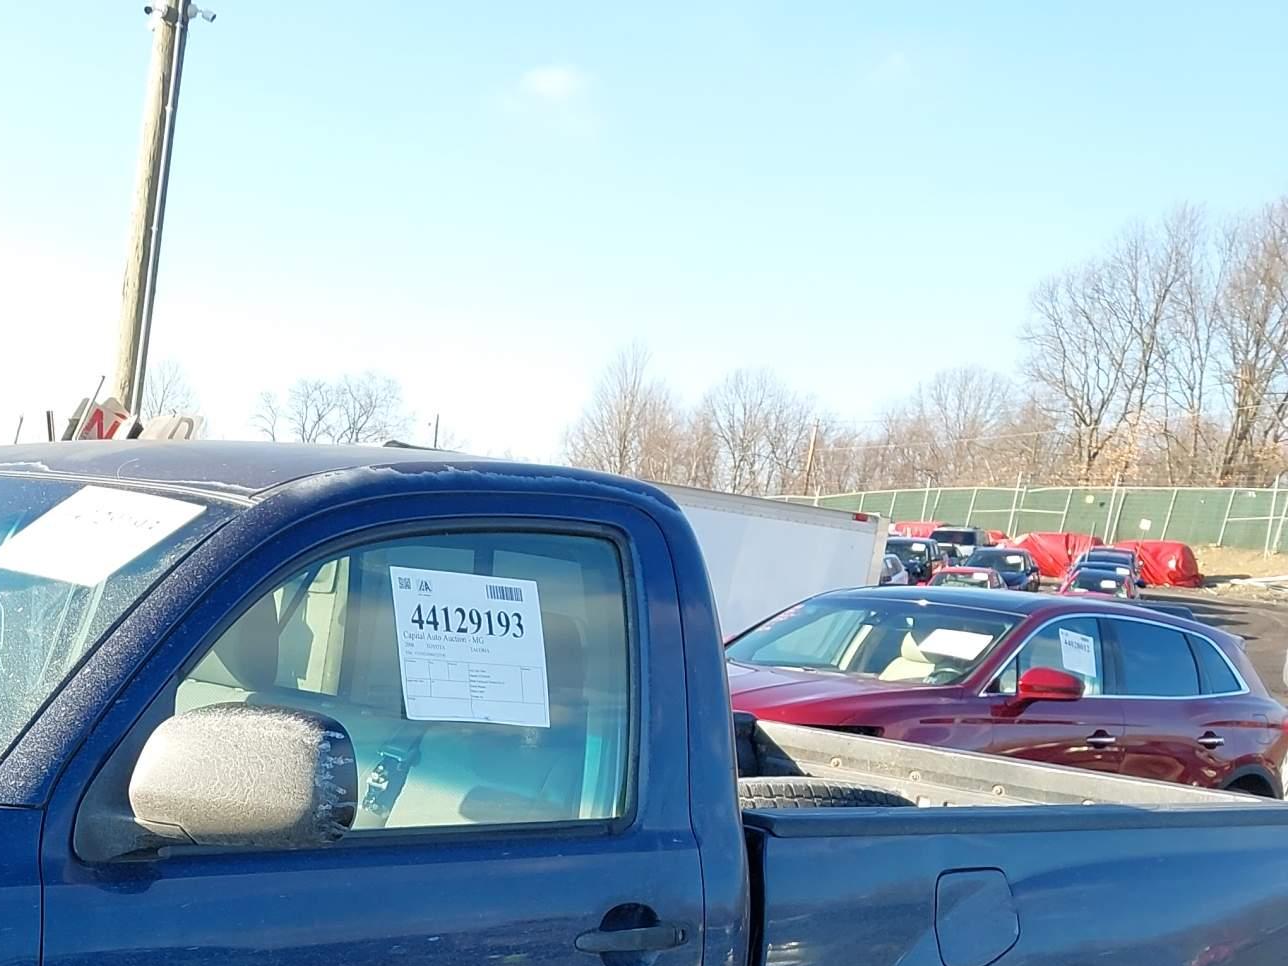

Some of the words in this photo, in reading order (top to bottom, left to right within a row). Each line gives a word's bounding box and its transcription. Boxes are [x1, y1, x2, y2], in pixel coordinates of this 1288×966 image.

[411, 603, 525, 639] 44129193
[403, 631, 425, 641] Capital
[426, 631, 442, 641] Auto
[443, 634, 467, 643] Auction
